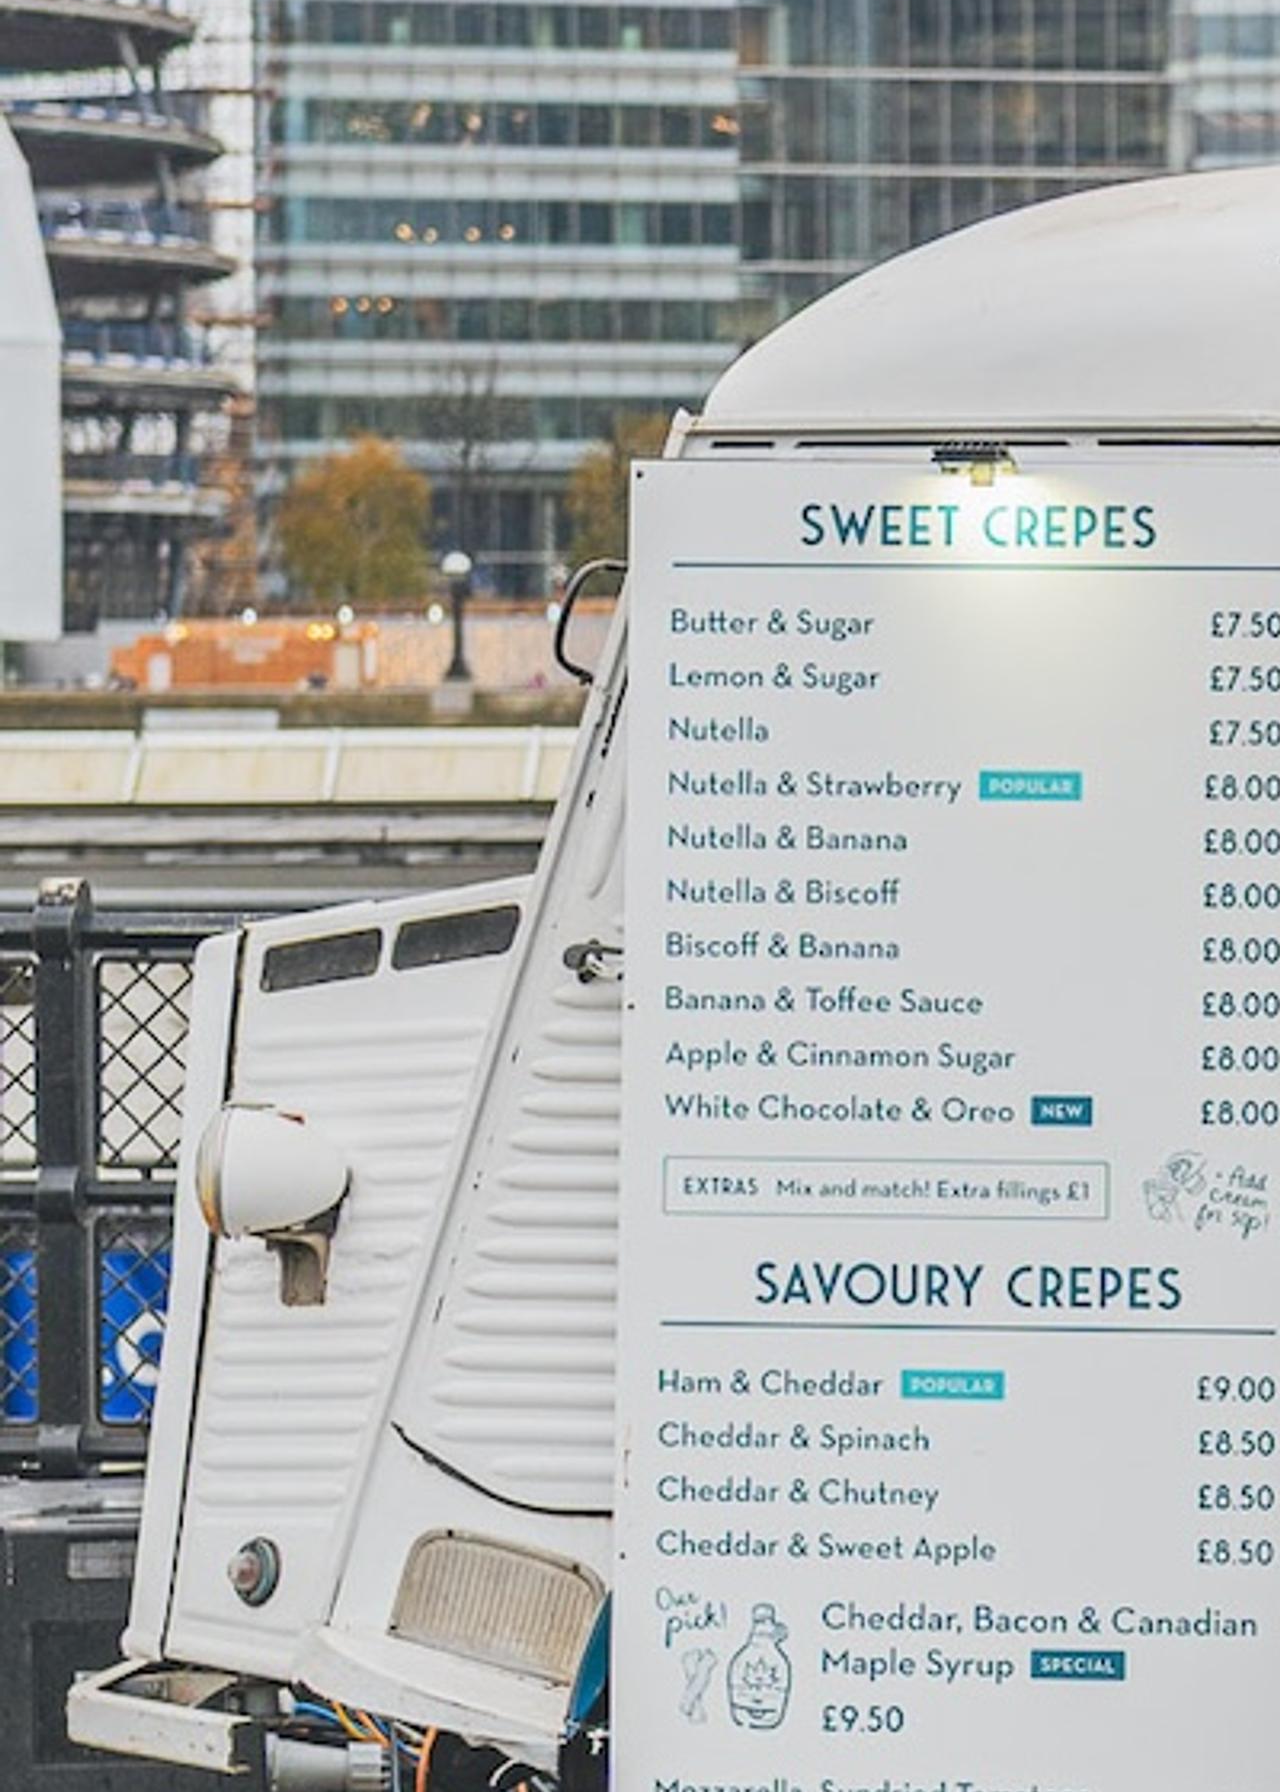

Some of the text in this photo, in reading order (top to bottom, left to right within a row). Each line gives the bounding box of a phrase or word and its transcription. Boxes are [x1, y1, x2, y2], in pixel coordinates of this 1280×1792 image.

[802, 504, 1156, 548] SWEET CREPES
[671, 608, 873, 641] Butter & Sugar
[670, 663, 879, 696] Lemon & Sugar
[669, 717, 768, 742] Nutella
[669, 770, 1072, 803] Nutella & Strawberry POPULAR
[668, 824, 907, 851] Nutella & Banana
[1205, 829, 1280, 855] £8.00
[668, 878, 899, 905] Nutella & Biscoff
[1204, 883, 1280, 909] £8.00
[666, 931, 899, 958] Biscoff & Banana
[1204, 938, 1280, 964] £8.00
[666, 986, 983, 1014] Banana & Toffee Sauce
[1203, 992, 1280, 1018] £8.00
[666, 1040, 1015, 1076] Apple & Cinnamon Sugar
[1203, 1046, 1279, 1071] £8.00
[666, 1094, 1082, 1122] White Chocolate & Oreo NEW
[1202, 1100, 1278, 1126] £8.00
[684, 1177, 1089, 1206] EXTRAS Mix and match! Extra fillings £1
[756, 1262, 1181, 1310] SAVOURY CREPES
[659, 1369, 996, 1396] Ham & Cheddar POPULAR
[1198, 1376, 1275, 1402] £9.00
[659, 1422, 929, 1456] Cheddar & Spinach
[1199, 1430, 1275, 1456] £8.50
[658, 1476, 938, 1511] Cheddar & Chutney
[1199, 1485, 1274, 1510] £8.50
[656, 1530, 996, 1566] Cheddar & Sweet Apple
[1198, 1539, 1273, 1565] £8.50
[822, 1602, 1256, 1636] Cheddar, Bacon & Canadian
[822, 1649, 1114, 1684] Maple Syrup SPECIAL
[823, 1705, 904, 1732] £9.50
